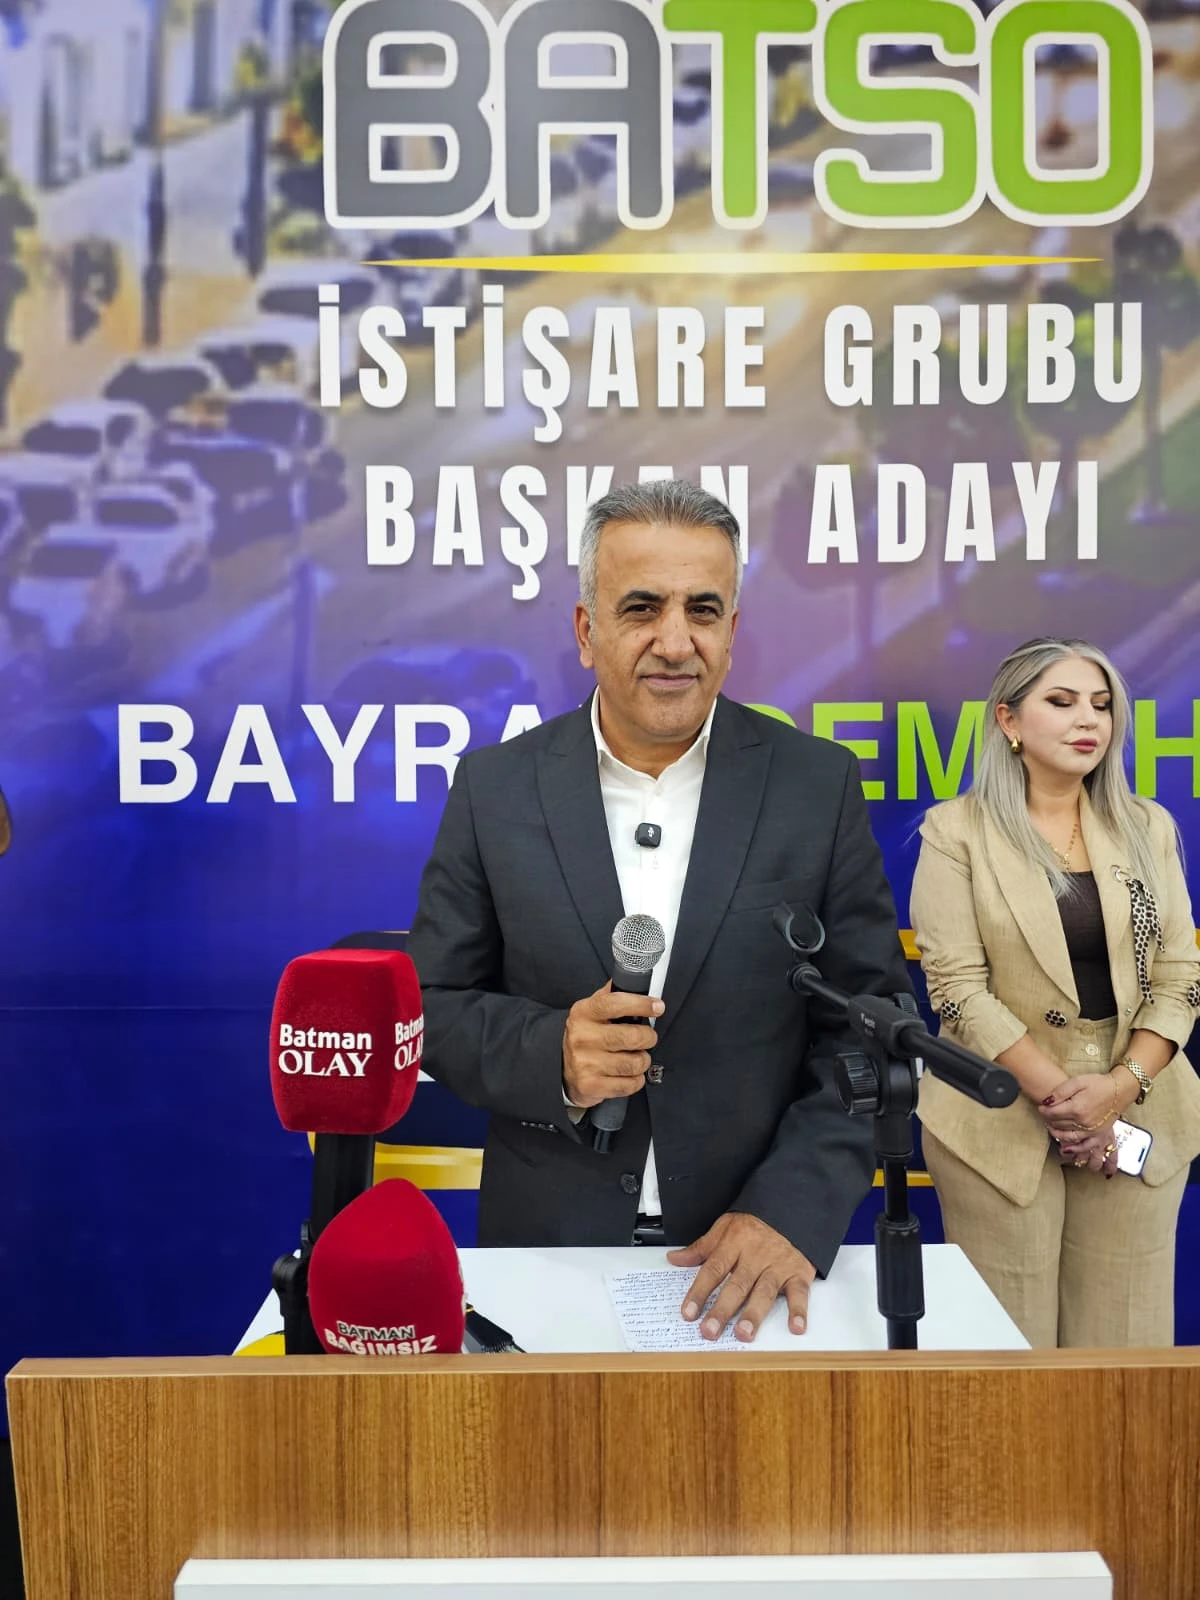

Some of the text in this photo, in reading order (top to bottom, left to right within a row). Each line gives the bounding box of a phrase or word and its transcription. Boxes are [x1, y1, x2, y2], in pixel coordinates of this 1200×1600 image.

[323, 0, 1153, 230] BATSO
[318, 284, 1142, 443] İSTİŞARE GRUBU
[366, 461, 1098, 600] BAŞK ADAYI
[118, 704, 582, 803] BAYR
[278, 1049, 374, 1077] OLAY
[280, 1023, 372, 1050] Batman
[394, 1031, 424, 1071] OLA
[336, 1320, 415, 1341] BATMAN
